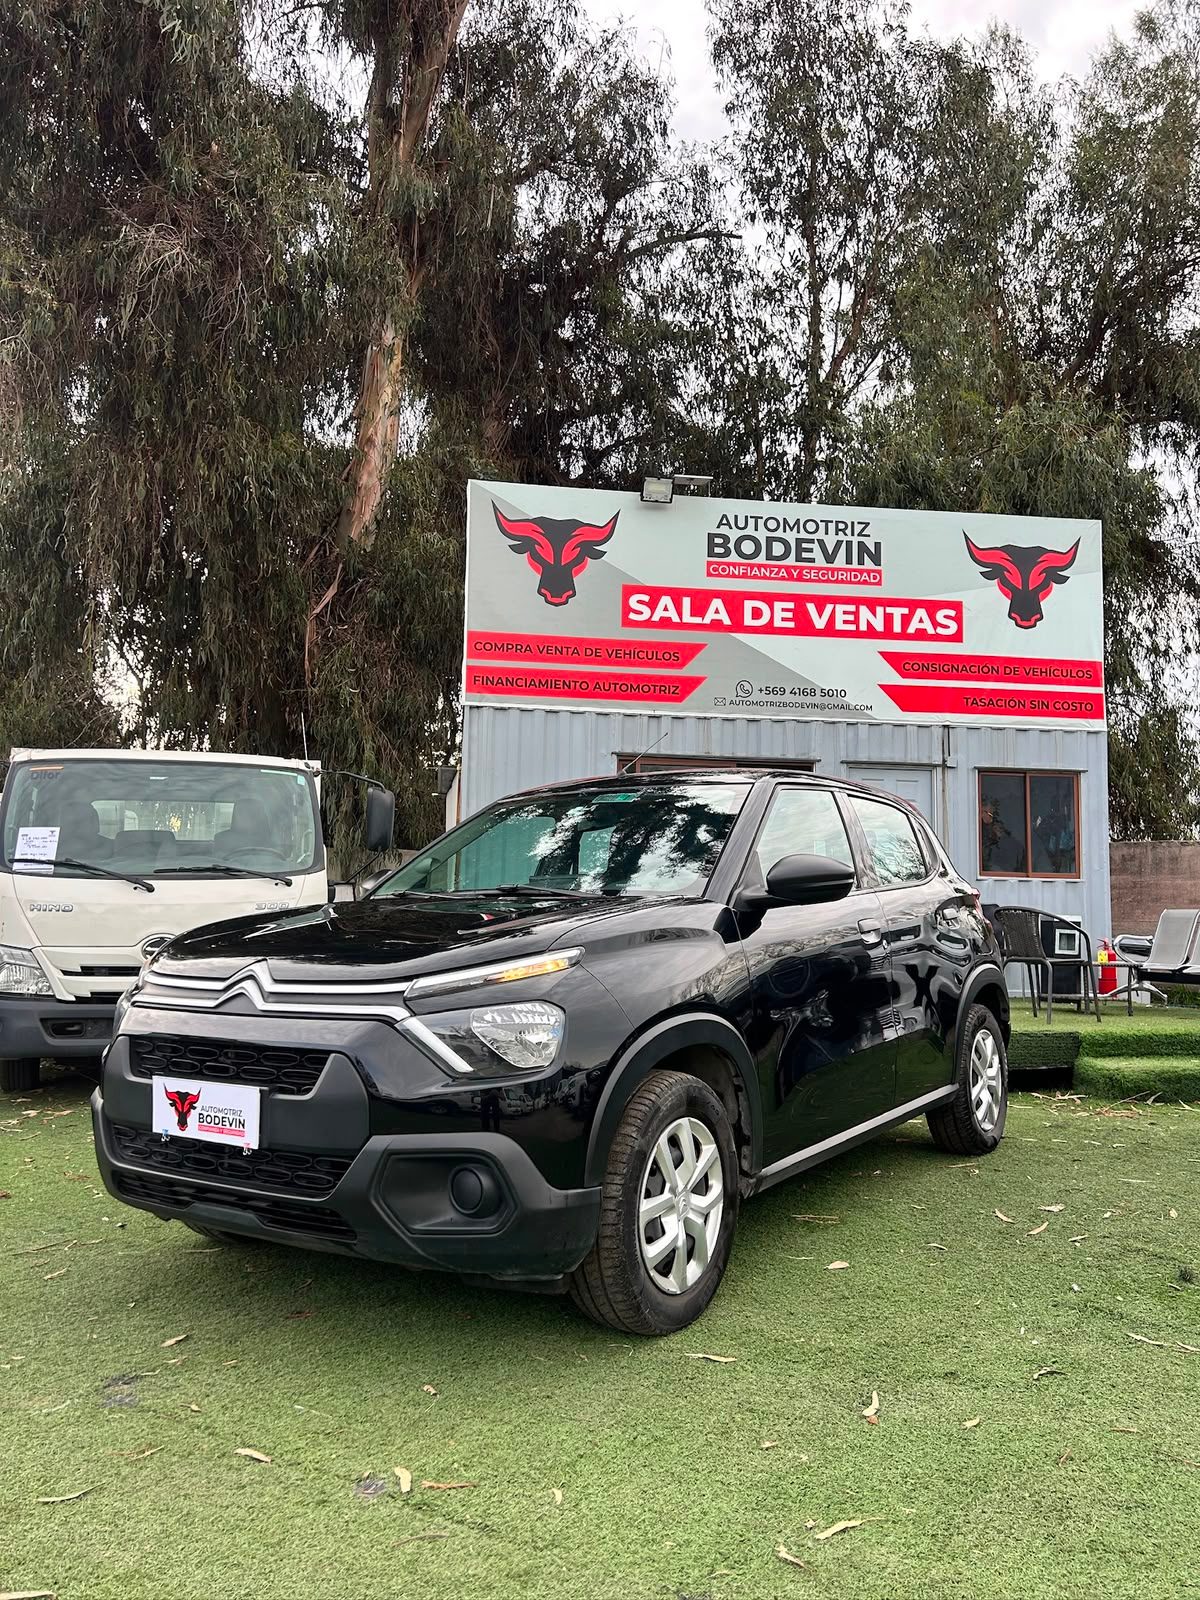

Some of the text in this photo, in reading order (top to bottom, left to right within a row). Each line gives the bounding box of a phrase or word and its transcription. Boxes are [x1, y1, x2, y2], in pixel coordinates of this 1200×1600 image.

[716, 513, 871, 537] AUTOMOTRIZ
[707, 532, 882, 566] BODEVIN
[709, 564, 880, 583] CONFIANZA Y SEGURIDAD
[627, 593, 959, 635] SALA DE VENTAS
[473, 641, 680, 662] COMPRA VENTA DE VEHÍCULOS
[902, 661, 1093, 680] CONSIGNACIÓN DE VEHÍCULOS
[473, 675, 680, 695] FINANCIAMIENTO AUTOMOTRIZ
[758, 686, 847, 698] +569 4168 5010
[728, 699, 873, 712] AUTOMOTRIZBODEVIN@GMAIL.COM
[963, 696, 1094, 712] TASACIÓN SIN COSTO
[29, 903, 74, 913] HINO
[198, 1112, 246, 1129] BODEVIN
[200, 1105, 243, 1117] AUTOMOTRIZ
